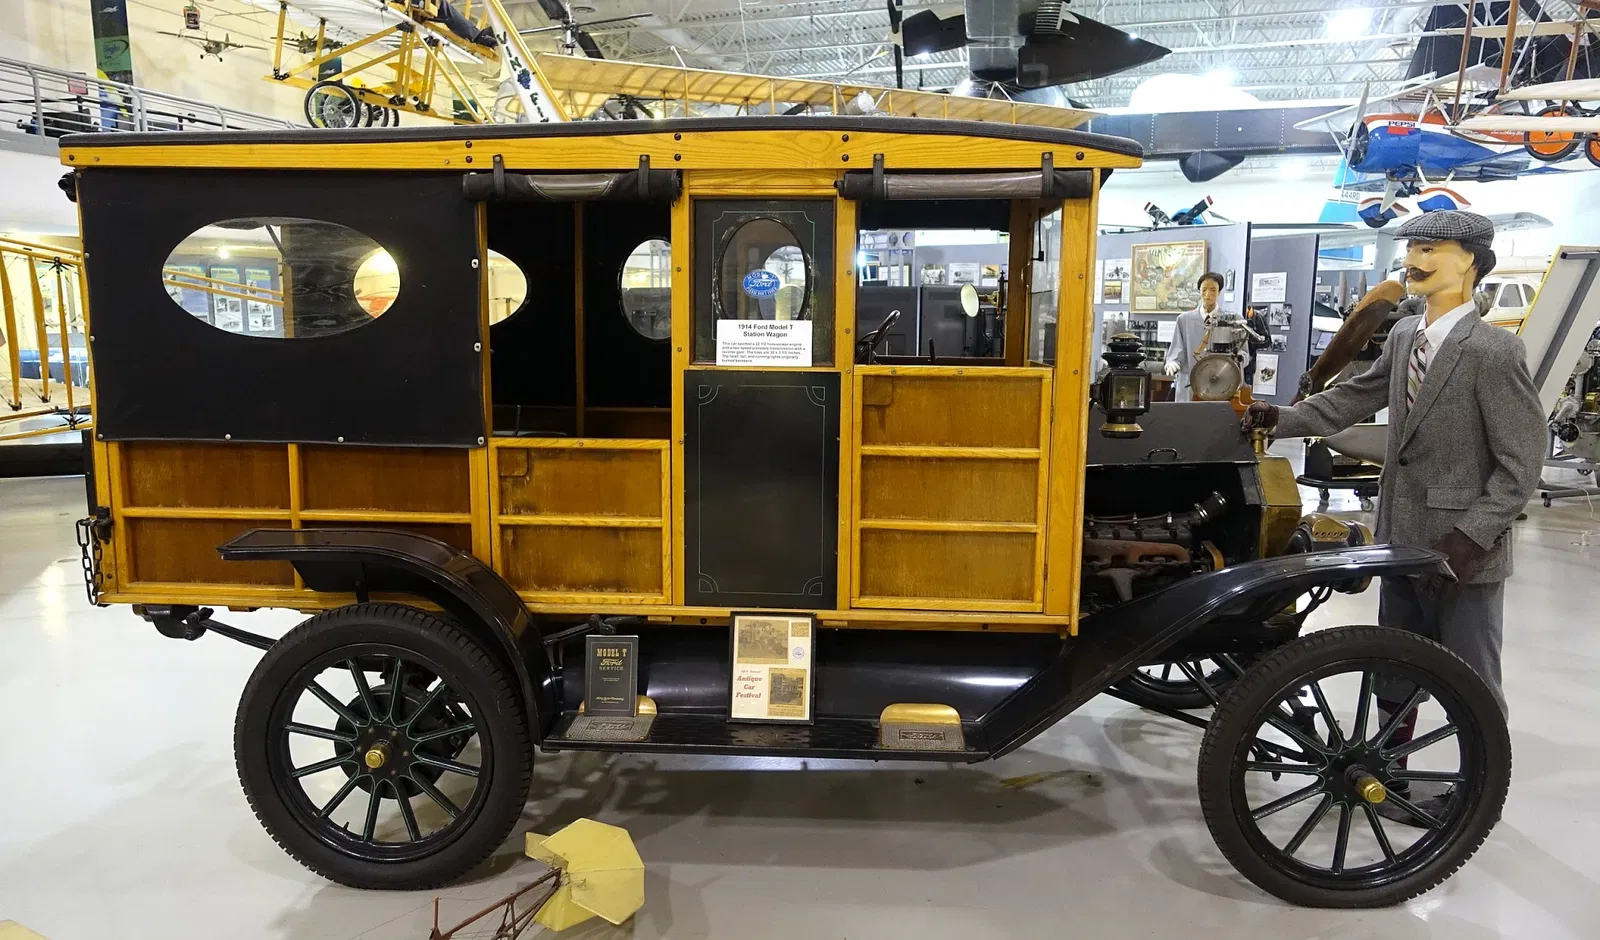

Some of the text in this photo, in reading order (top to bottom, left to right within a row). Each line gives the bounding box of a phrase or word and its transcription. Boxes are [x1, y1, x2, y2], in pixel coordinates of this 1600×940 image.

[1388, 120, 1416, 128] PEPSI
[749, 278, 774, 288] Ford
[596, 648, 627, 657] MODEL T
[600, 658, 623, 666] Ford
